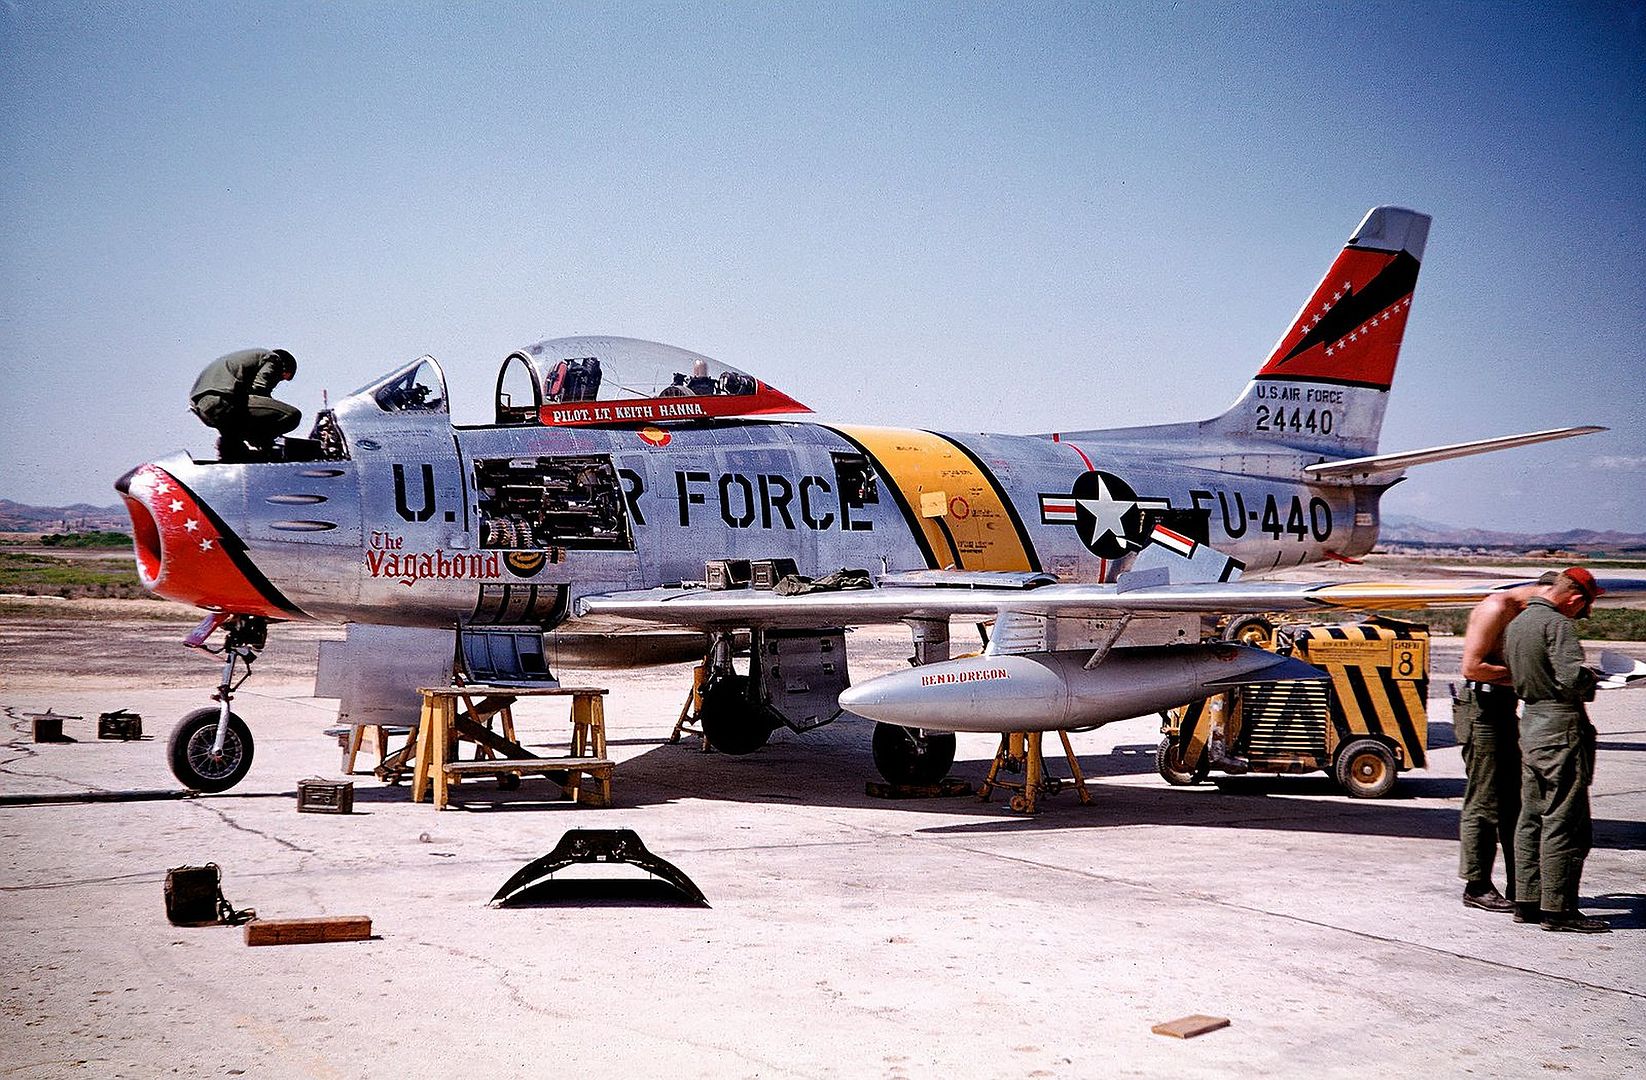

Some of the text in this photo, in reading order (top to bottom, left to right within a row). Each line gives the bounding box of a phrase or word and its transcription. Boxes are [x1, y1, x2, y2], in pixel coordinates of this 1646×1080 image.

[1306, 388, 1344, 404] FORCE
[615, 405, 654, 419] KEITH
[658, 403, 708, 417] HANNA.
[1256, 404, 1333, 435] 24440
[675, 470, 874, 531] FORCE
[370, 529, 403, 550] The
[366, 549, 500, 587] Vagabond
[1398, 651, 1414, 676] 8
